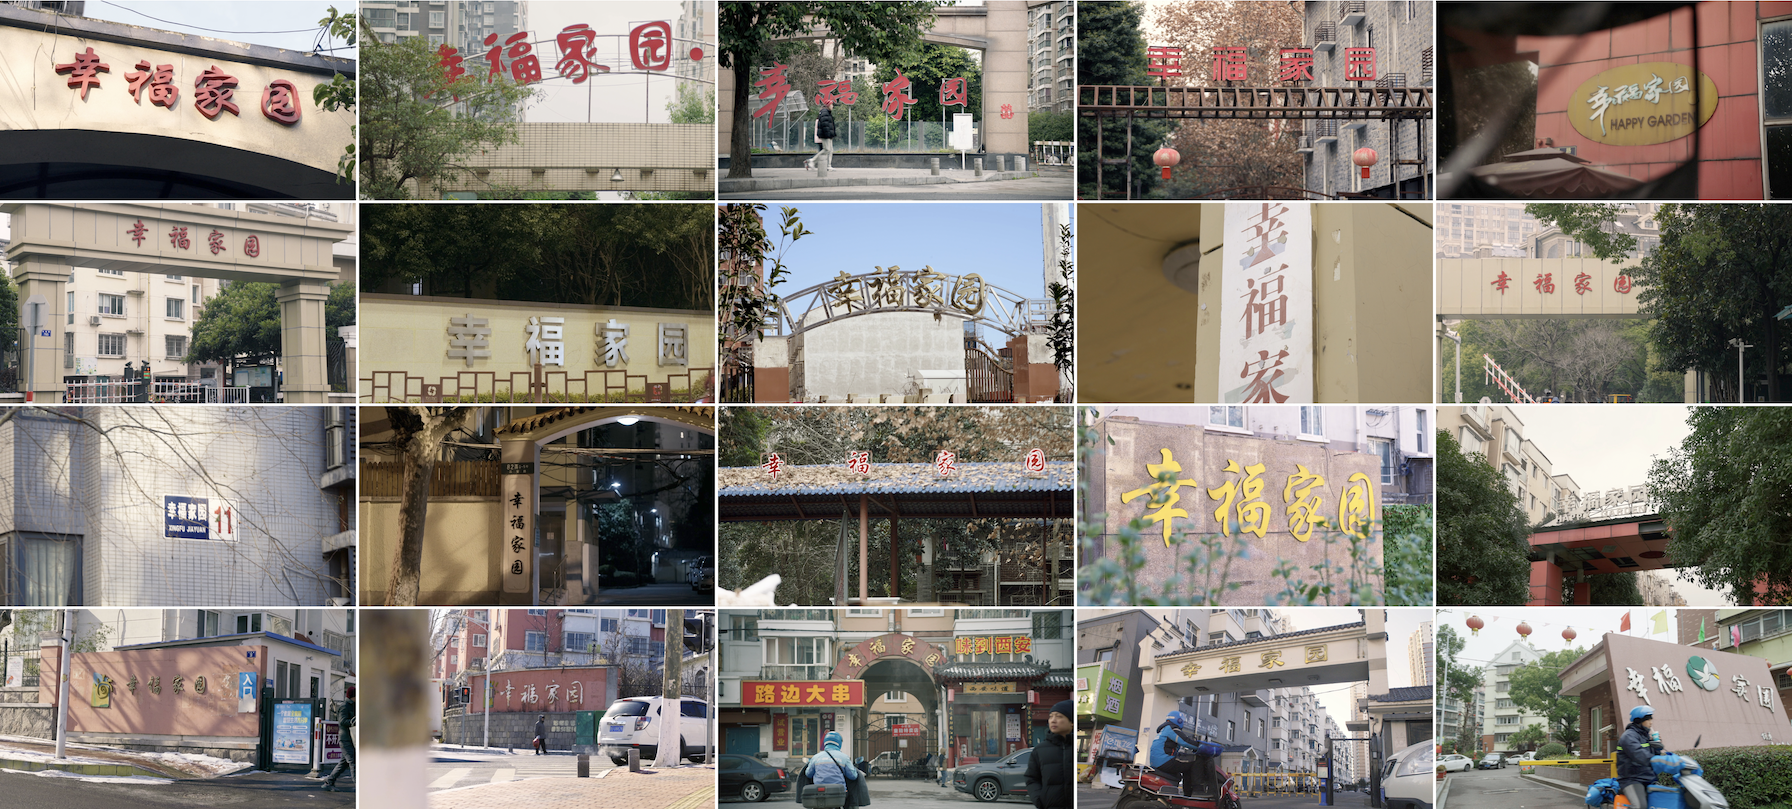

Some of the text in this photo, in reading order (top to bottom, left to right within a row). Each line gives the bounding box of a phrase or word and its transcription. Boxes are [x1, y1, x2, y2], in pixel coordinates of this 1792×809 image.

[1147, 46, 1377, 81] 幸福家园
[55, 47, 302, 126] 幸福家园
[754, 61, 968, 129] 幸福家园
[1587, 73, 1691, 137] 幸福家园
[1611, 112, 1697, 131] HAPPY GARDEN
[126, 219, 261, 258] 幸福家园
[828, 265, 986, 315] 幸福家园
[1490, 271, 1632, 296] 幸福家园
[447, 313, 689, 367] 幸福家园
[762, 448, 1047, 480] 幸福家园
[167, 501, 207, 521] 幸福家园
[1121, 448, 1375, 548] 幸福家园
[168, 524, 206, 533] XINGFU JIAYUAN
[214, 506, 232, 534] 11
[509, 492, 526, 576] 幸福家园
[848, 637, 941, 668] 幸福家园
[955, 636, 1032, 655] 味到西安
[1180, 643, 1328, 679] 幸福家园
[127, 674, 207, 696] 幸福家园
[243, 674, 253, 697] 入口
[500, 679, 584, 706] 幸福家园
[754, 683, 851, 704] 路边大串
[1104, 676, 1124, 714] 烟酒
[1625, 664, 1775, 714] 幸福 家园
